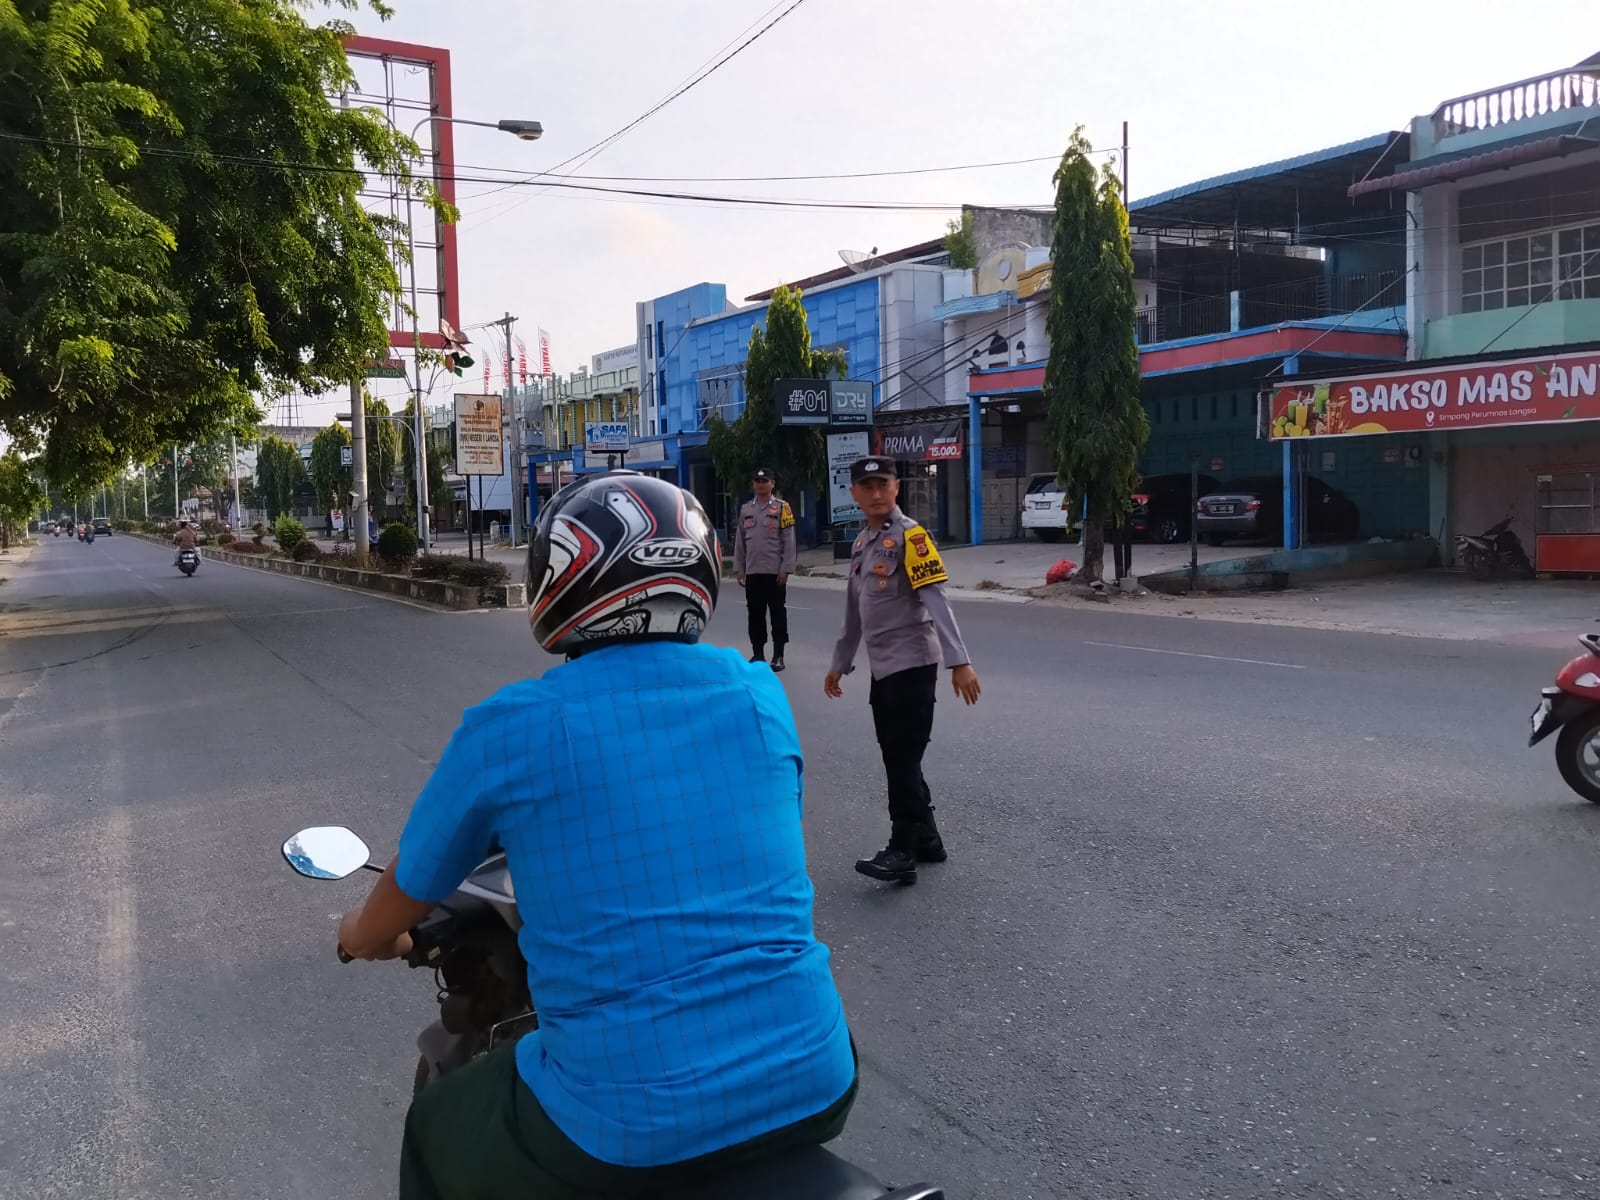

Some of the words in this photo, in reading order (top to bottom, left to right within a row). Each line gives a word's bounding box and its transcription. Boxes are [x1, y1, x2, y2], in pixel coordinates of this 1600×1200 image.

[1349, 379, 1448, 414] BAKSO
[1458, 369, 1534, 406] MAS
[1545, 363, 1600, 398] AN
[788, 389, 827, 412] #01
[835, 392, 866, 408] DRY
[1438, 412, 1470, 421] Simpang
[1471, 410, 1508, 418] Perumnas
[1509, 407, 1537, 417] Langsa
[601, 424, 628, 434] SAFA
[884, 435, 925, 455] PRIMA
[643, 546, 695, 558] VOG
[873, 549, 898, 559] POLRI
